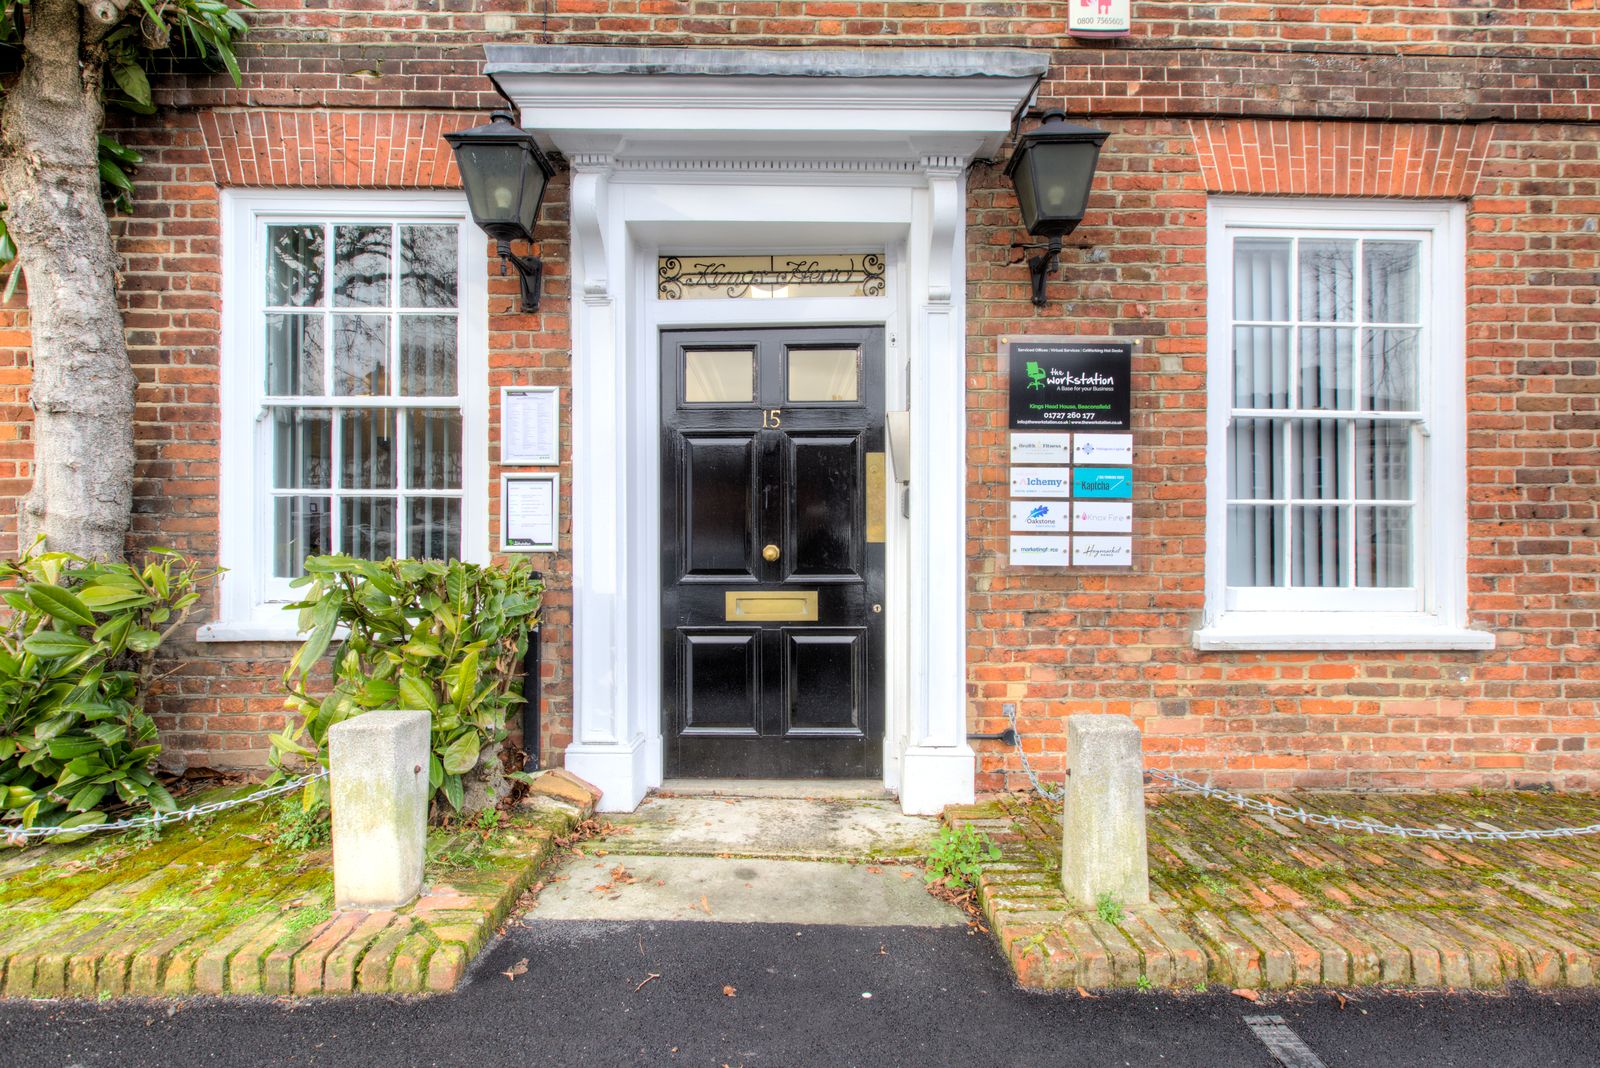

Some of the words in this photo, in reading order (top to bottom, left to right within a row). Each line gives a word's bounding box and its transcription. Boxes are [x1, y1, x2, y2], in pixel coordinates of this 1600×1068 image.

[1076, 17, 1094, 25] 0800
[1050, 368, 1064, 376] the
[1046, 371, 1114, 386] workstation
[762, 410, 780, 428] 15
[1082, 480, 1110, 491] Kaptcha
